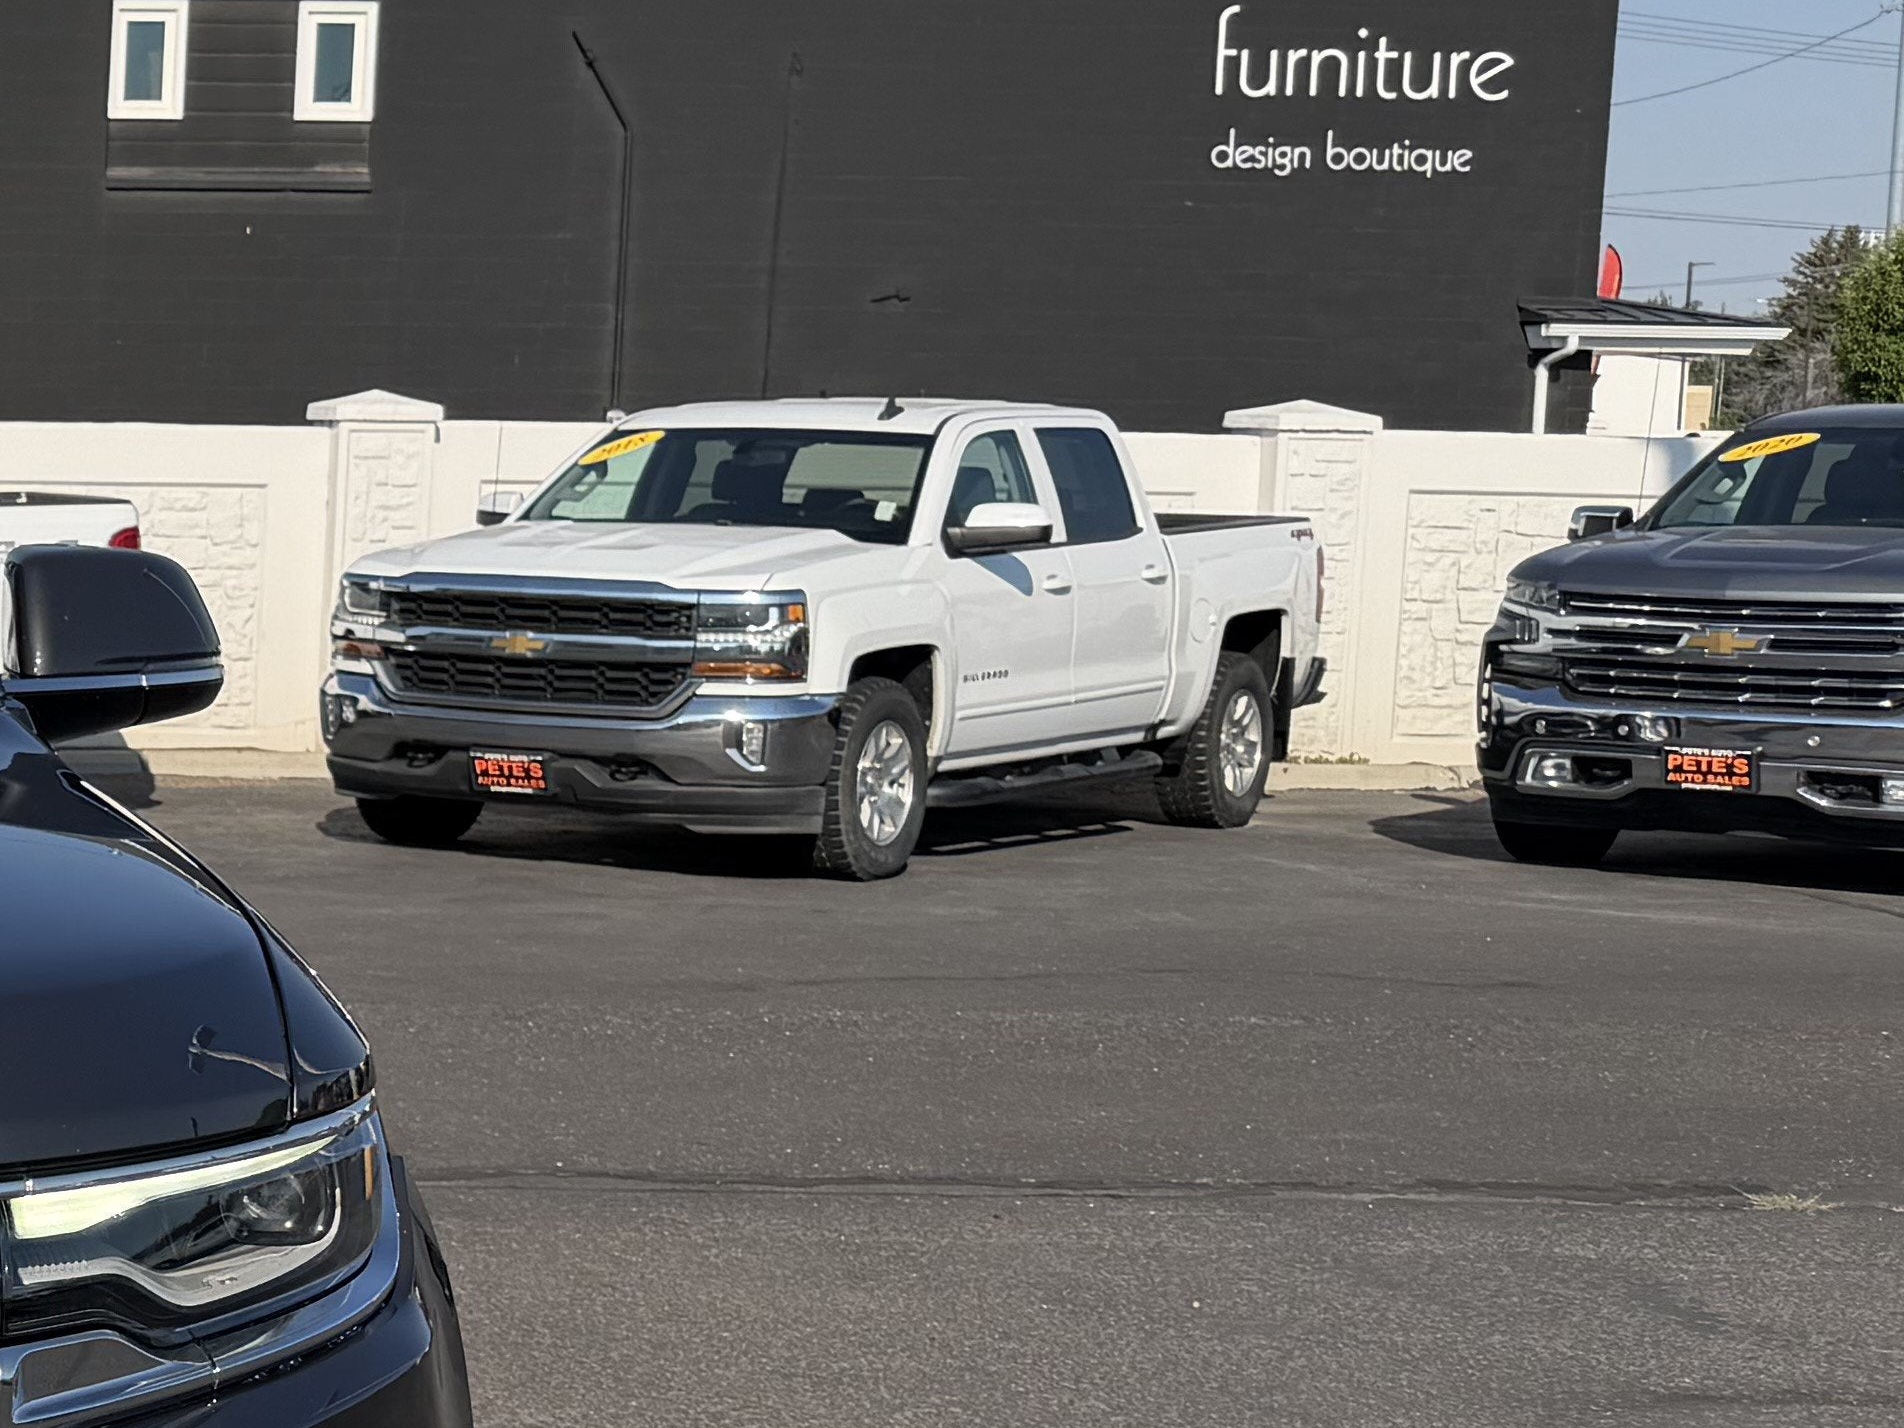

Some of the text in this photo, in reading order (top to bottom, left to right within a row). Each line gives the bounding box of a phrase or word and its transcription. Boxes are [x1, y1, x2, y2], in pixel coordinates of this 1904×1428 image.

[1214, 4, 1515, 102] furniture
[1210, 127, 1474, 179] design boutique
[474, 759, 543, 779] PETE'S
[1667, 753, 1750, 774] PETE'S
[1667, 772, 1704, 783] AUTO
